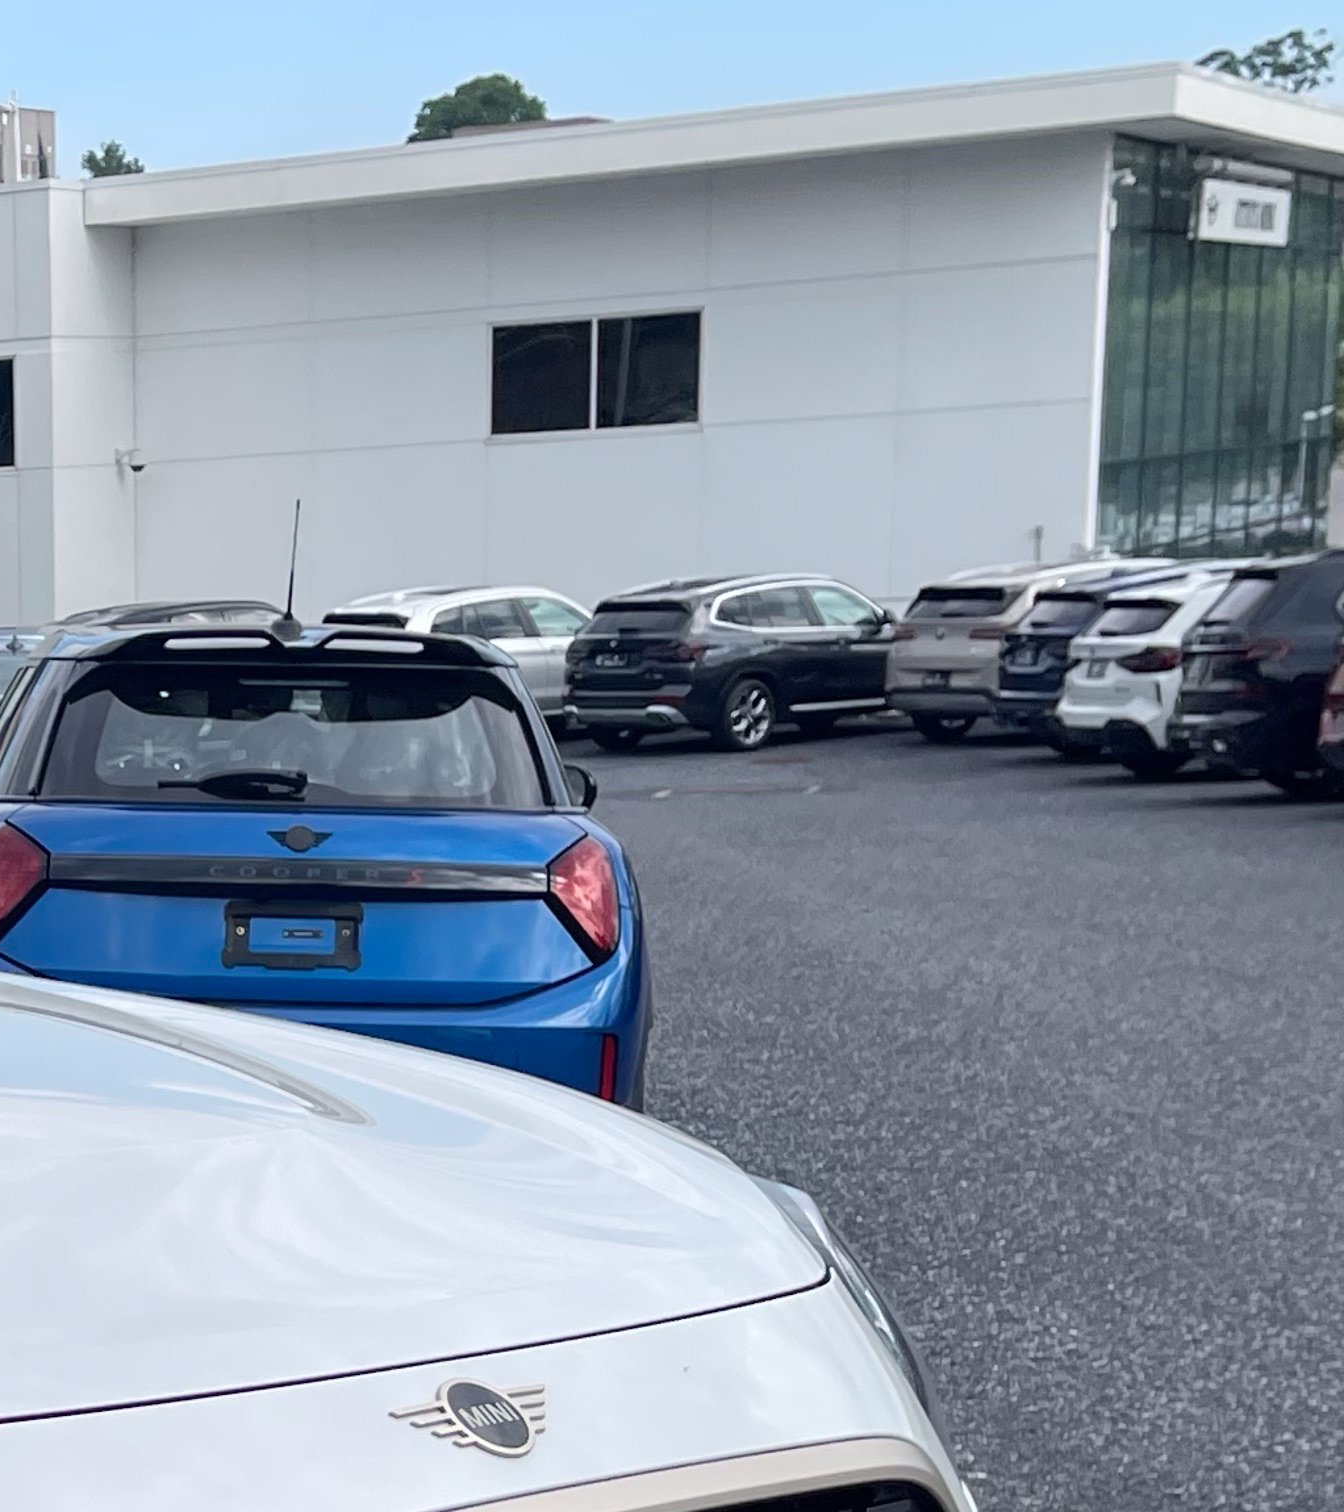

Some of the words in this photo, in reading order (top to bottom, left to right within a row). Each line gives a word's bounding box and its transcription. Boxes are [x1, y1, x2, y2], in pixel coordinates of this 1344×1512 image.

[208, 864, 380, 881] COOPER
[404, 868, 424, 887] S
[457, 1400, 521, 1429] MINI
